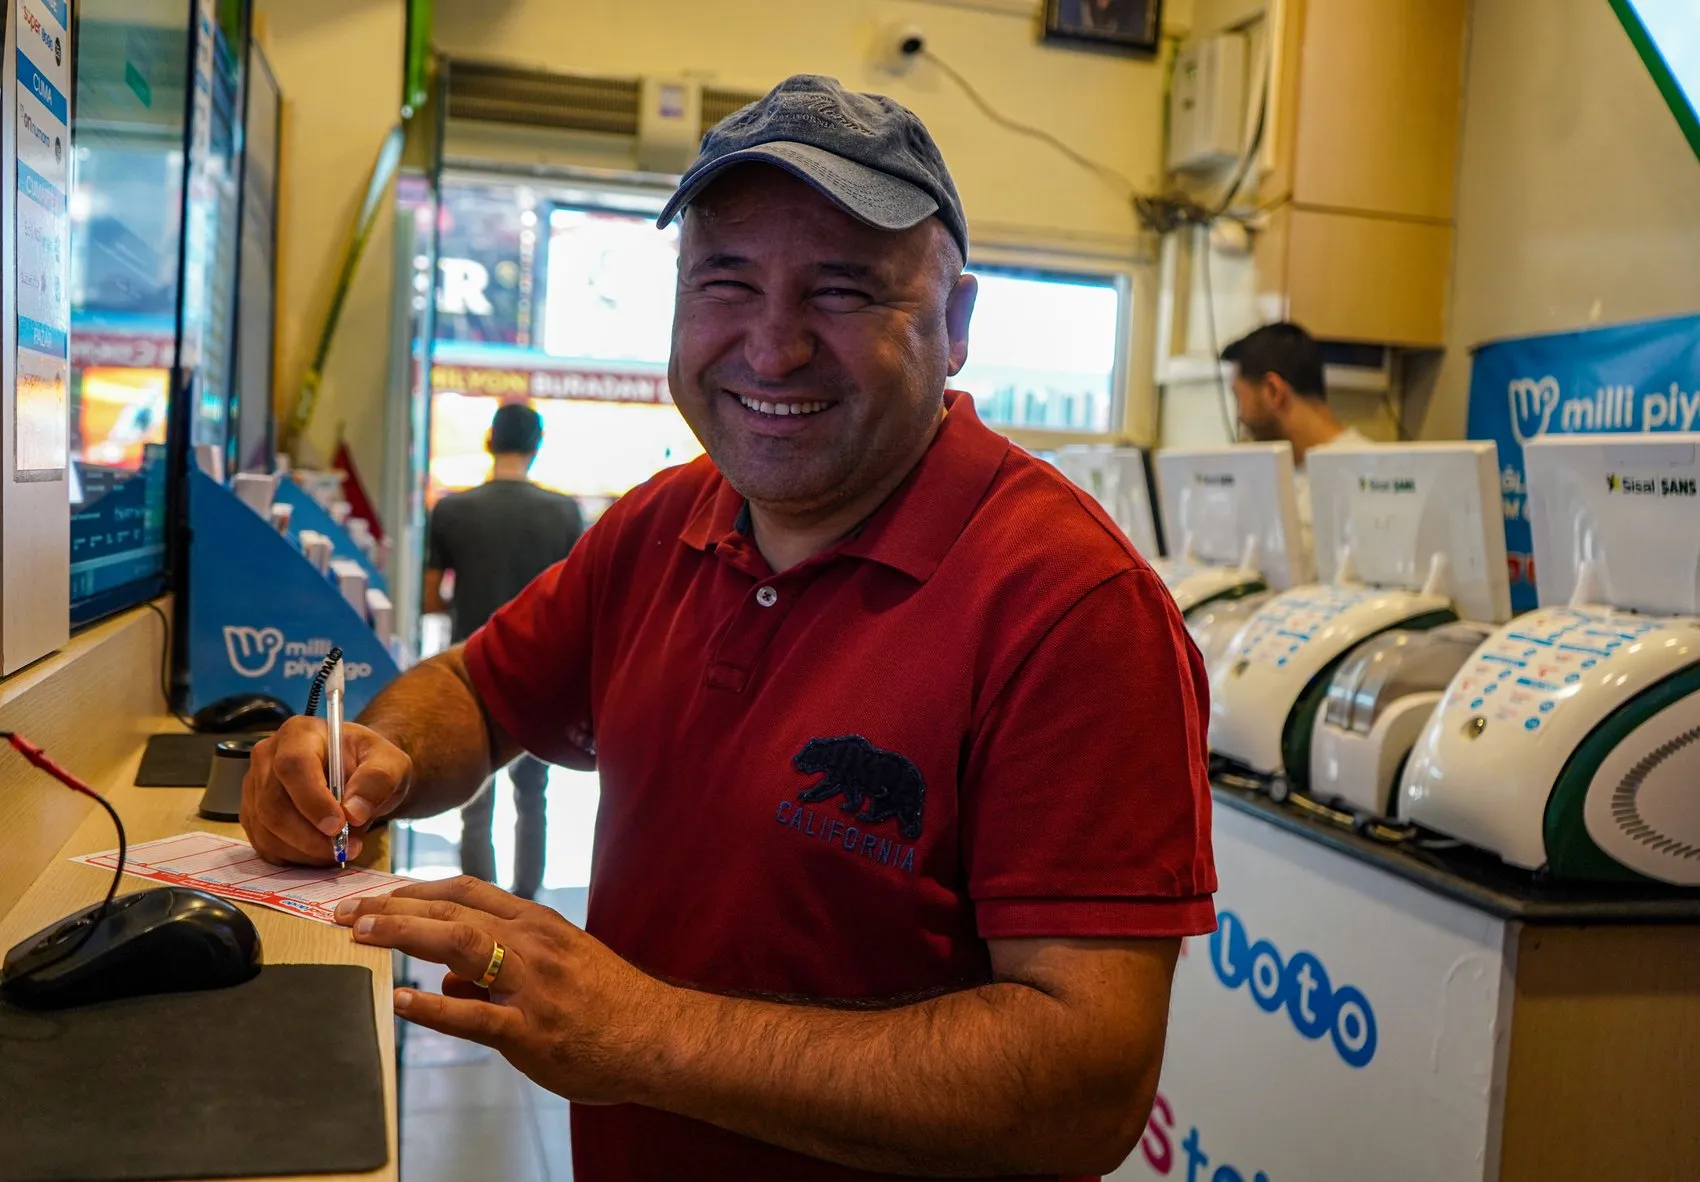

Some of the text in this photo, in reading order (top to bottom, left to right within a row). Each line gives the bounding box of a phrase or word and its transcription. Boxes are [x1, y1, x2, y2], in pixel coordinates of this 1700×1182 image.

[32, 72, 53, 106] CUMA
[1560, 381, 1700, 433] milli piy
[1622, 476, 1655, 494] Sisal
[284, 657, 373, 681] piygo
[776, 800, 916, 873] CALIFORNIA
[1219, 917, 1369, 1053] loto
